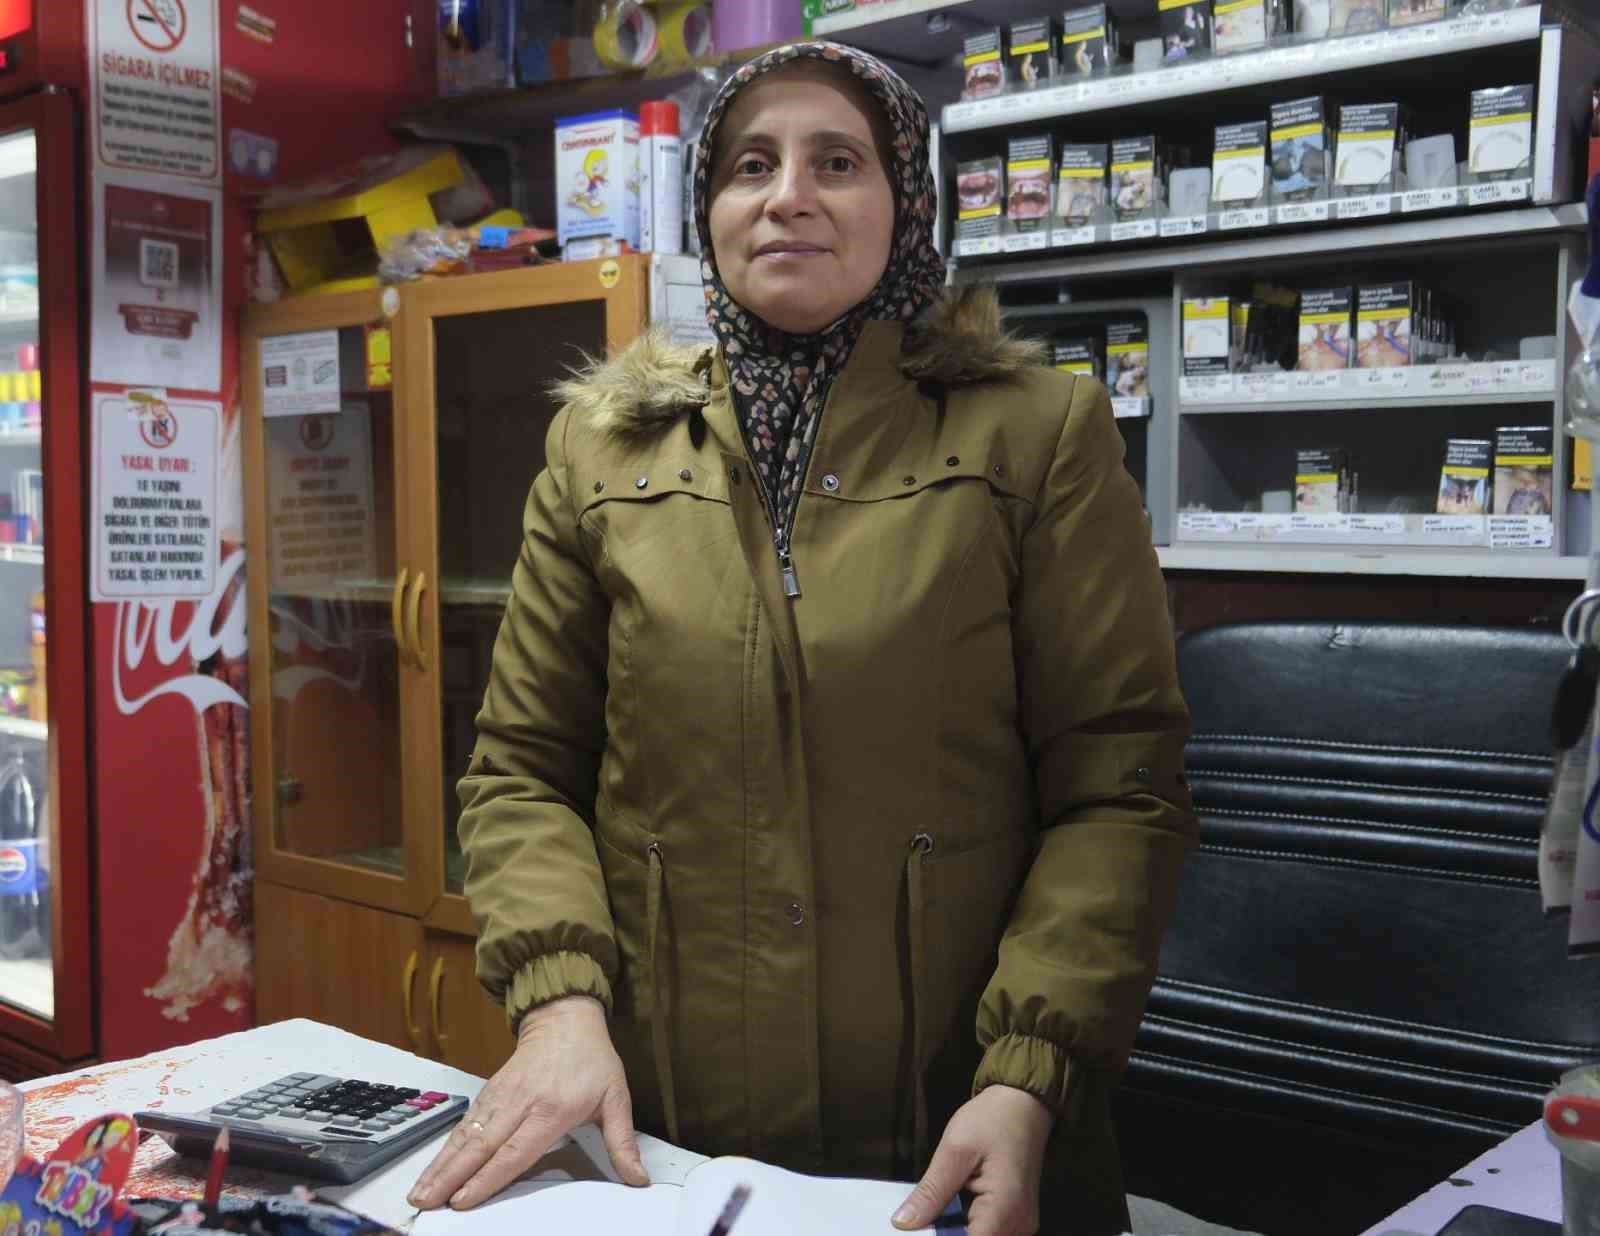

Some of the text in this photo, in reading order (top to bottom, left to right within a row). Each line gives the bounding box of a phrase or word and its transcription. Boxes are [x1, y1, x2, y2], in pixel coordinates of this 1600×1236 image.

[103, 50, 210, 89] SİGARA İÇİLMEZ
[121, 455, 154, 471] YASAL
